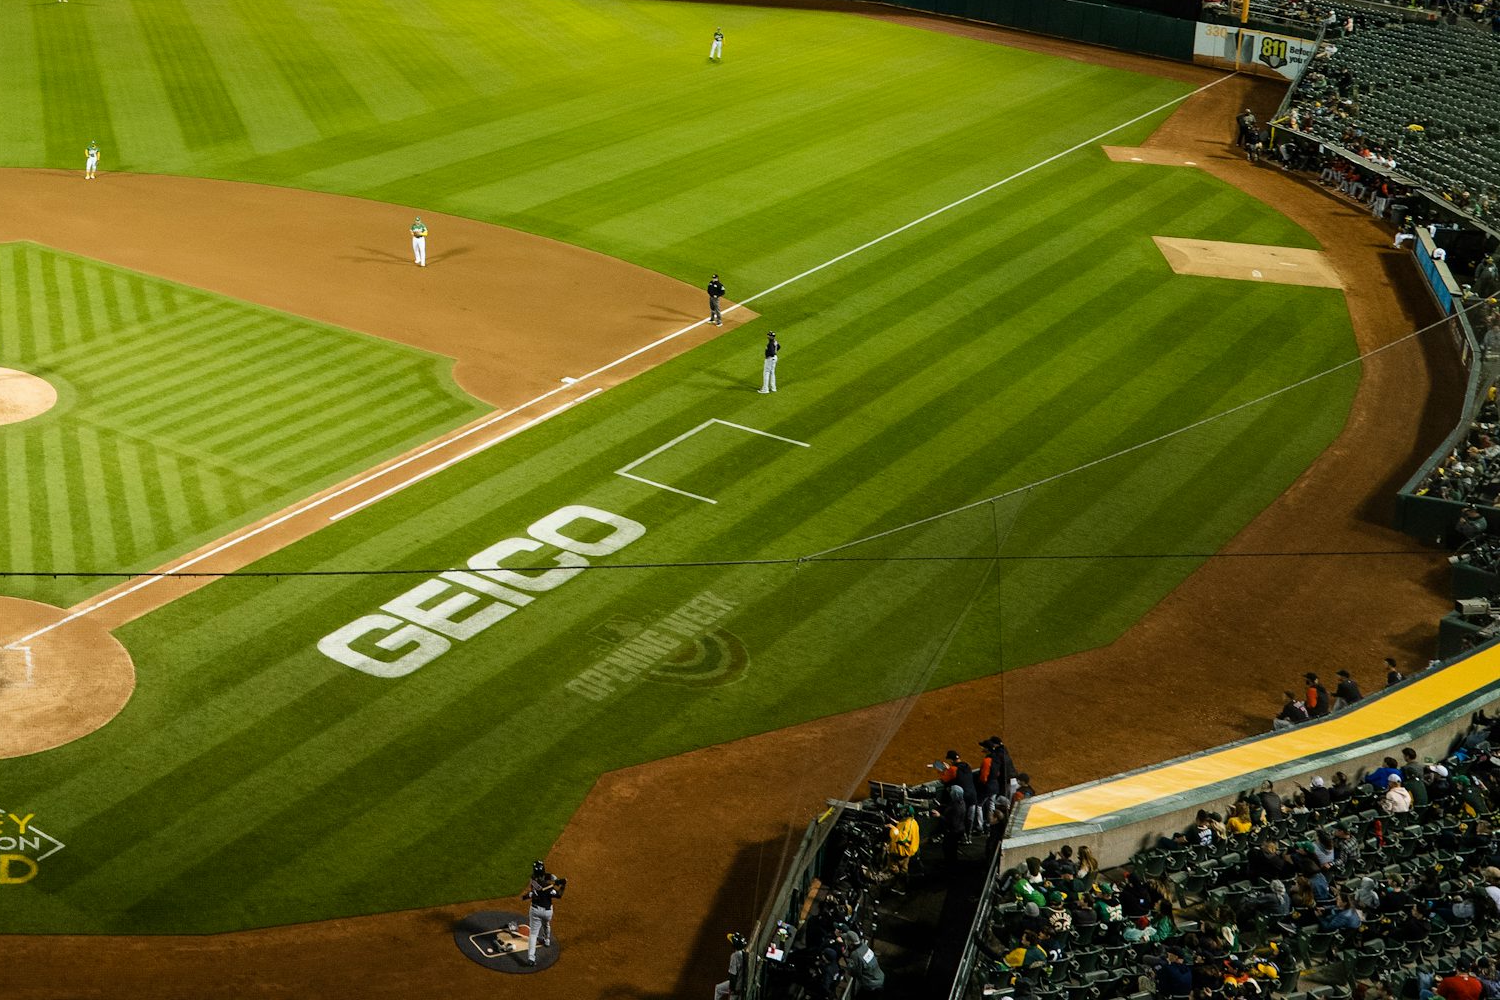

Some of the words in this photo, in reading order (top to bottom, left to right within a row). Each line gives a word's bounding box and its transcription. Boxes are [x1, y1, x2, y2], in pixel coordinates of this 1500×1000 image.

[1205, 25, 1228, 38] 330
[1262, 38, 1286, 59] 811
[1290, 46, 1312, 56] Befor
[317, 505, 646, 678] GEICO
[565, 629, 681, 701] OPENING
[656, 590, 740, 637] WEEK
